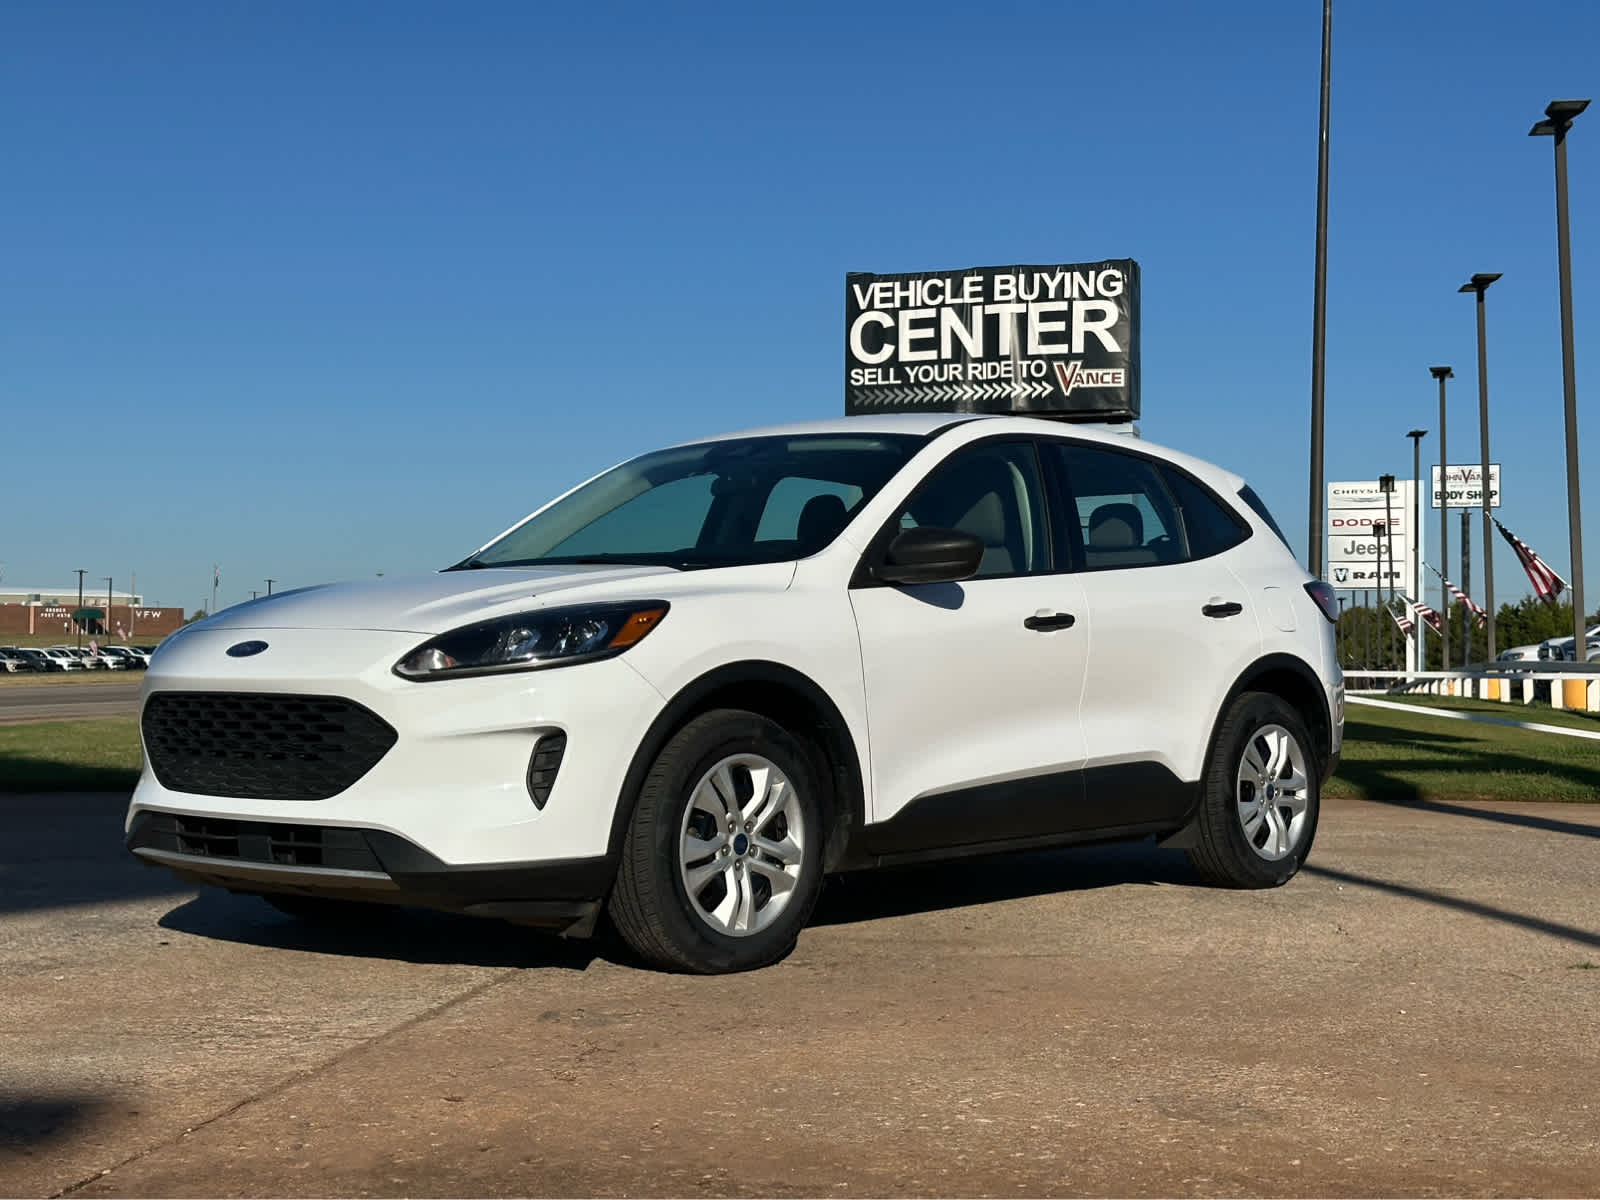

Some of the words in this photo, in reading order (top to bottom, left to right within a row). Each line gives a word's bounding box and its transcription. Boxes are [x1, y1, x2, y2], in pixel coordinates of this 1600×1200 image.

[853, 275, 985, 310] VEHICLE
[993, 269, 1124, 302] BUYING
[849, 299, 1122, 364] CENTER
[850, 367, 902, 386] SELL
[905, 363, 963, 384] YOUR
[967, 360, 1013, 381] RIDE
[1019, 359, 1047, 378] TO
[1052, 360, 1126, 397] VANCE
[1466, 490, 1498, 499] SHP
[1332, 518, 1400, 527] DODGE
[1343, 539, 1390, 558] Jeep
[1352, 571, 1400, 580] RAM
[135, 610, 161, 618] VFW
